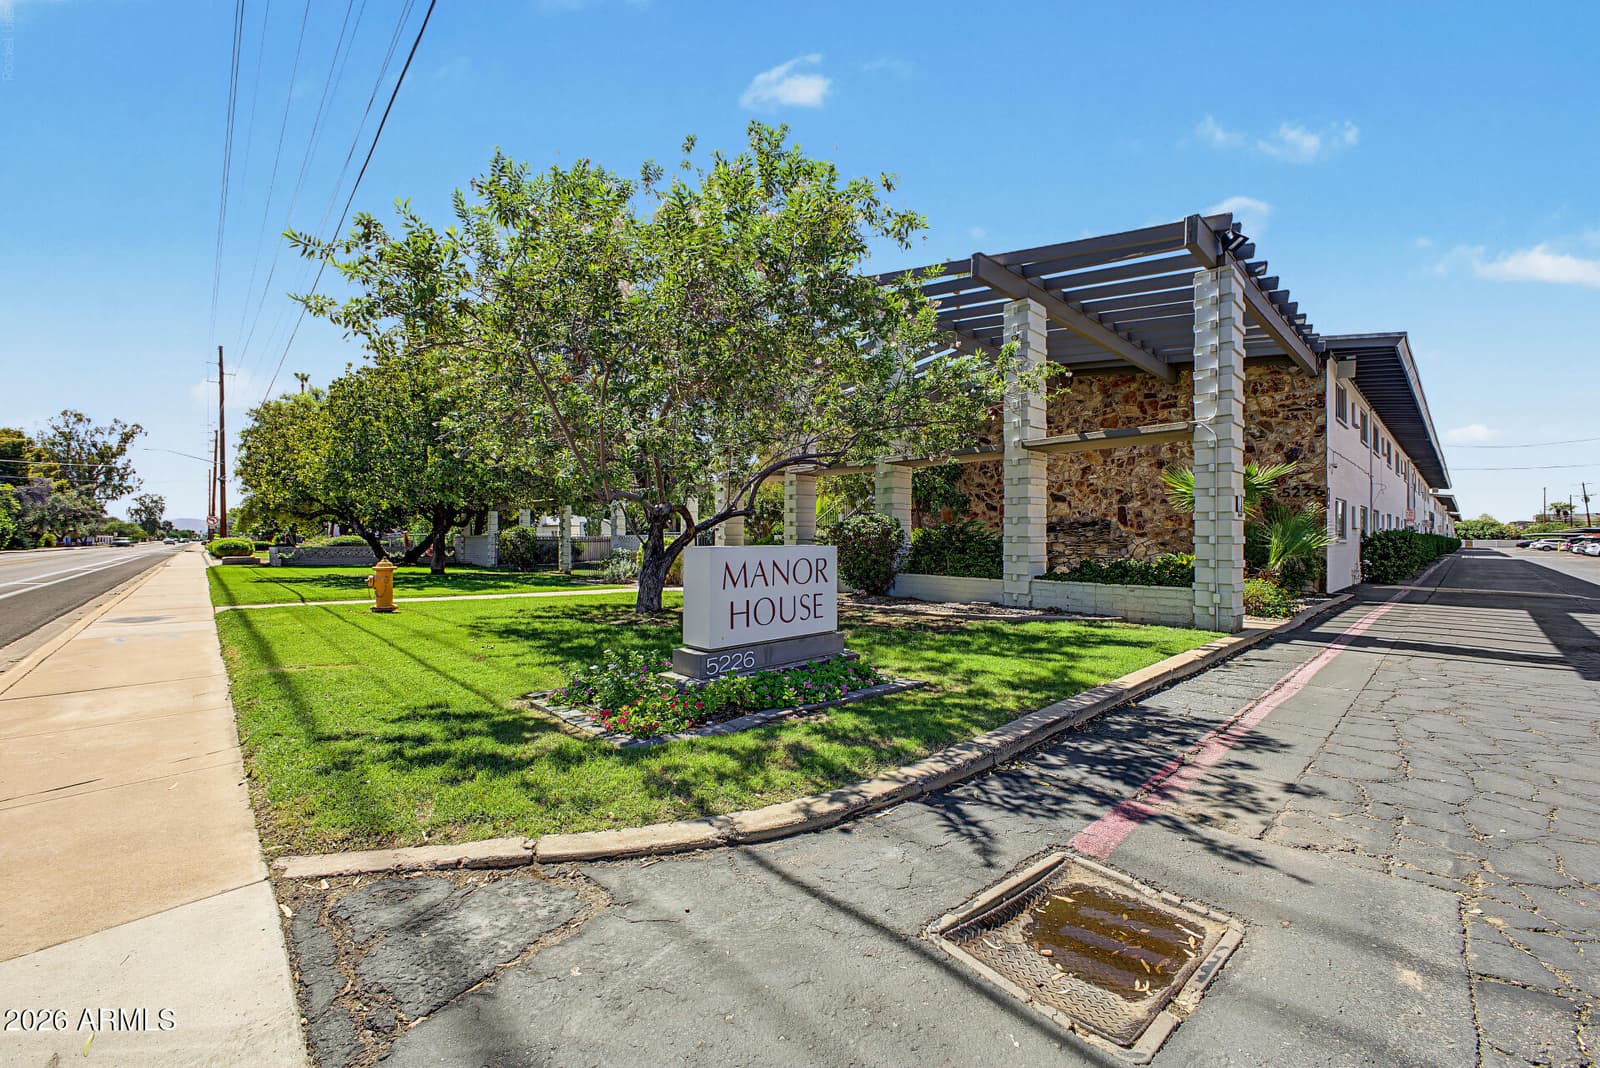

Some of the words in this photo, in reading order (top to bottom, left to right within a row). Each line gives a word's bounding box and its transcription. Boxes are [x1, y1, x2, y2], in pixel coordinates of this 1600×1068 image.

[1281, 485, 1326, 498] 5226
[722, 557, 828, 590] MANOR
[730, 593, 824, 630] HOUSE
[706, 651, 755, 675] 5226
